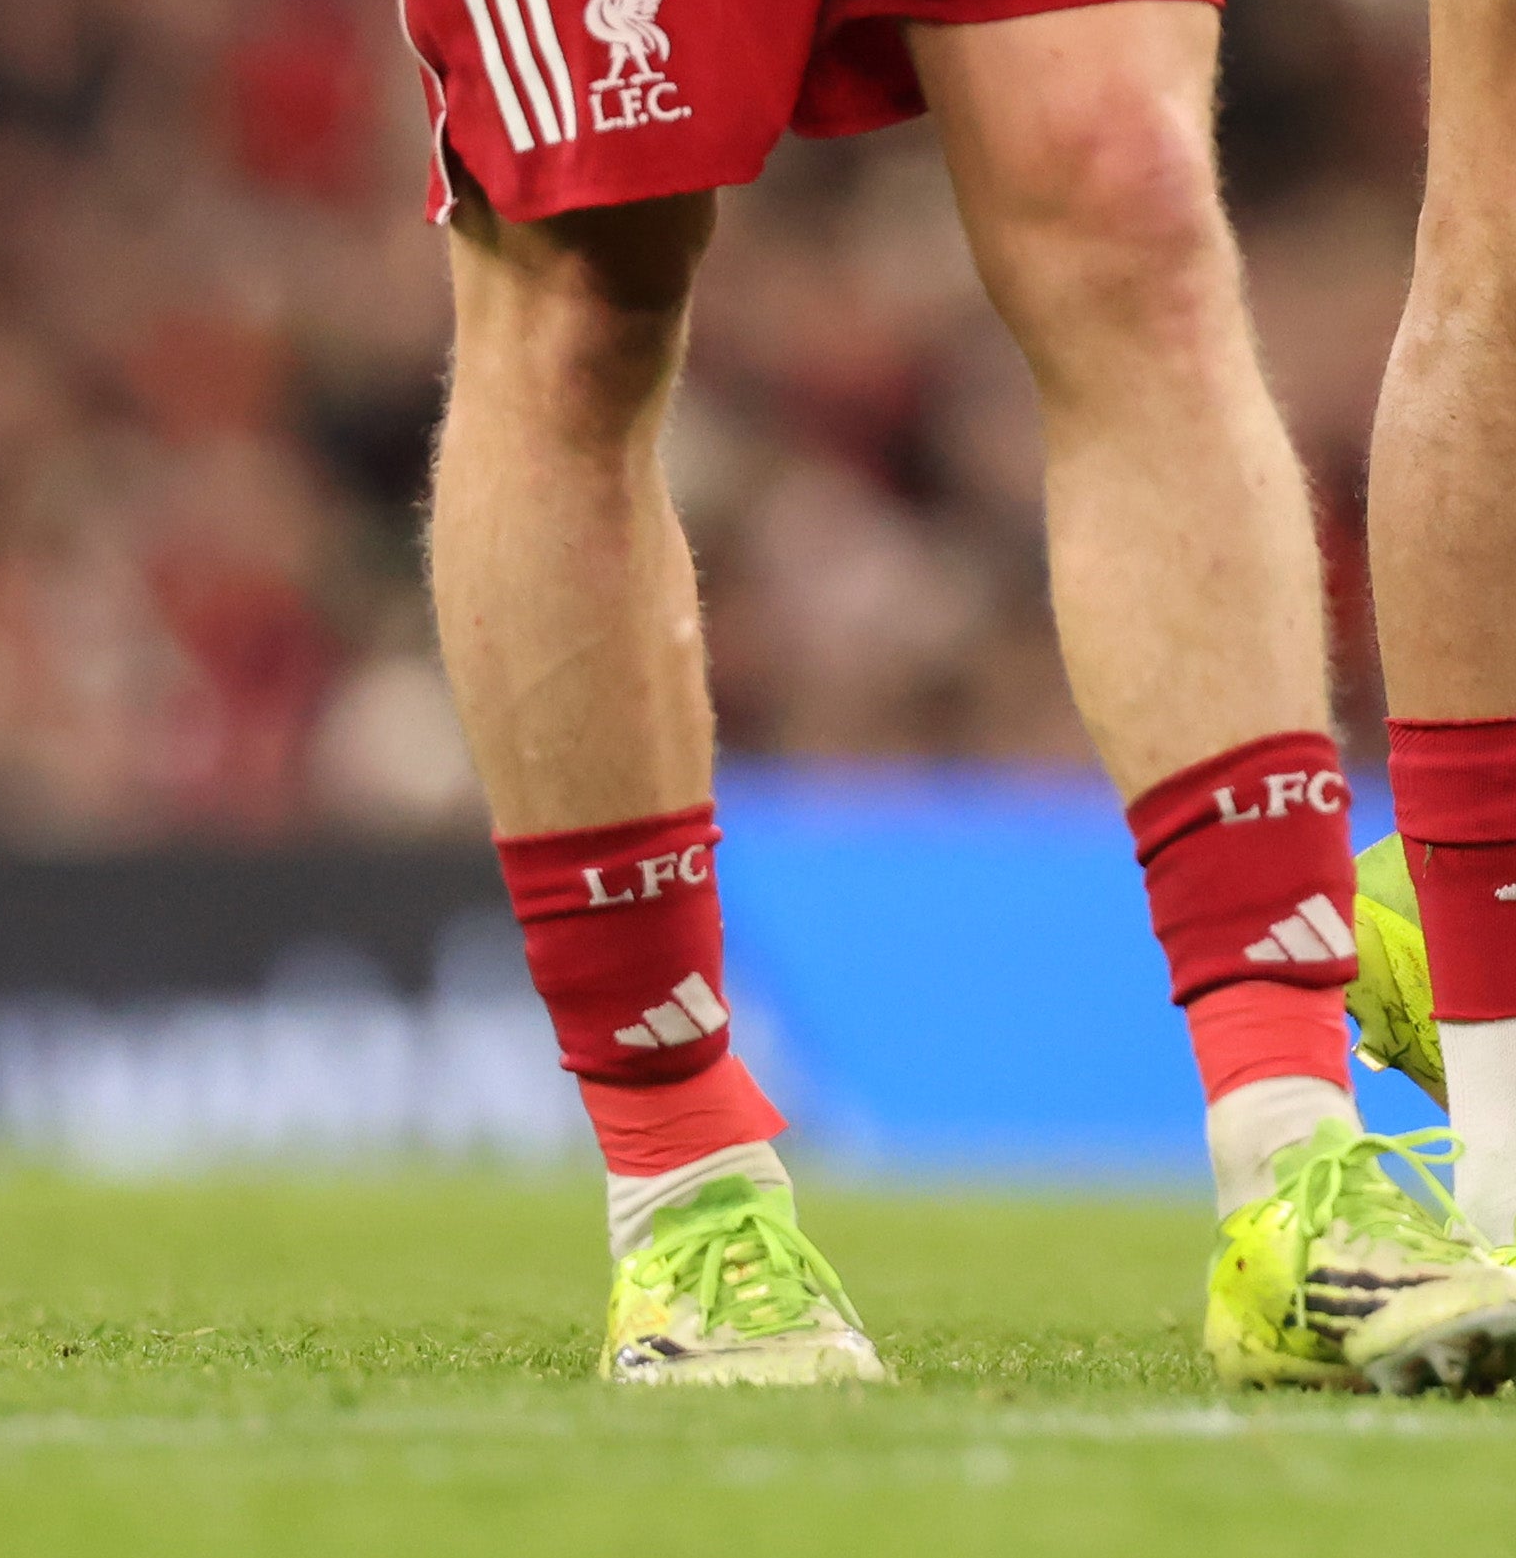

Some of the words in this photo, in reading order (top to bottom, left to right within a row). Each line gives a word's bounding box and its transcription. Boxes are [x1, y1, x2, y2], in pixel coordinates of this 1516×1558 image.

[588, 81, 693, 134] L.F.C.
[1211, 769, 1345, 825] LFC
[582, 843, 709, 907] LFC
